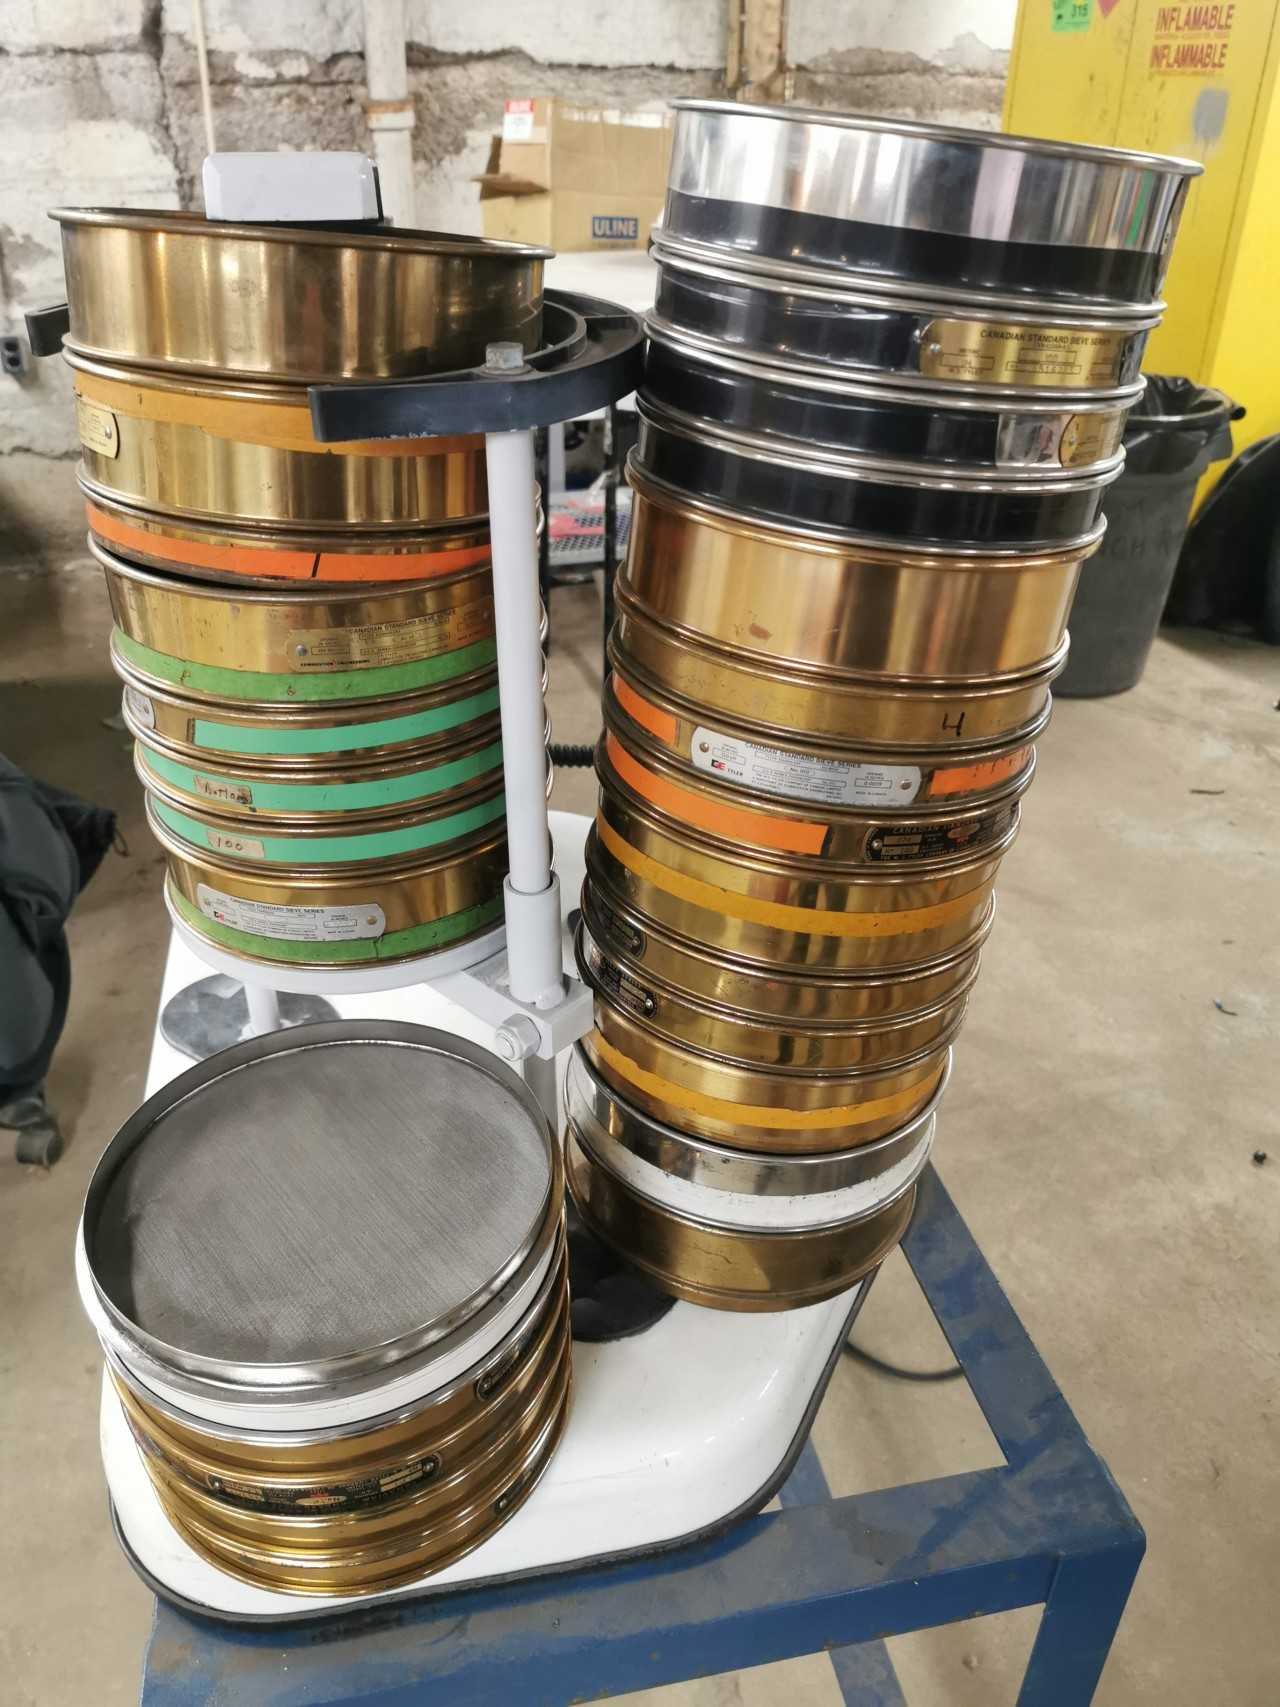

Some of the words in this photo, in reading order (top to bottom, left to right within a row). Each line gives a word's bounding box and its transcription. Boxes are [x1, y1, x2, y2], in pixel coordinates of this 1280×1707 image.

[1155, 5, 1235, 32] INFLAMABLE
[593, 218, 637, 238] ULINE
[980, 329, 1025, 341] CANADIAN
[1027, 333, 1069, 344] STANDARD
[942, 711, 965, 737] 4
[217, 836, 243, 851] 100
